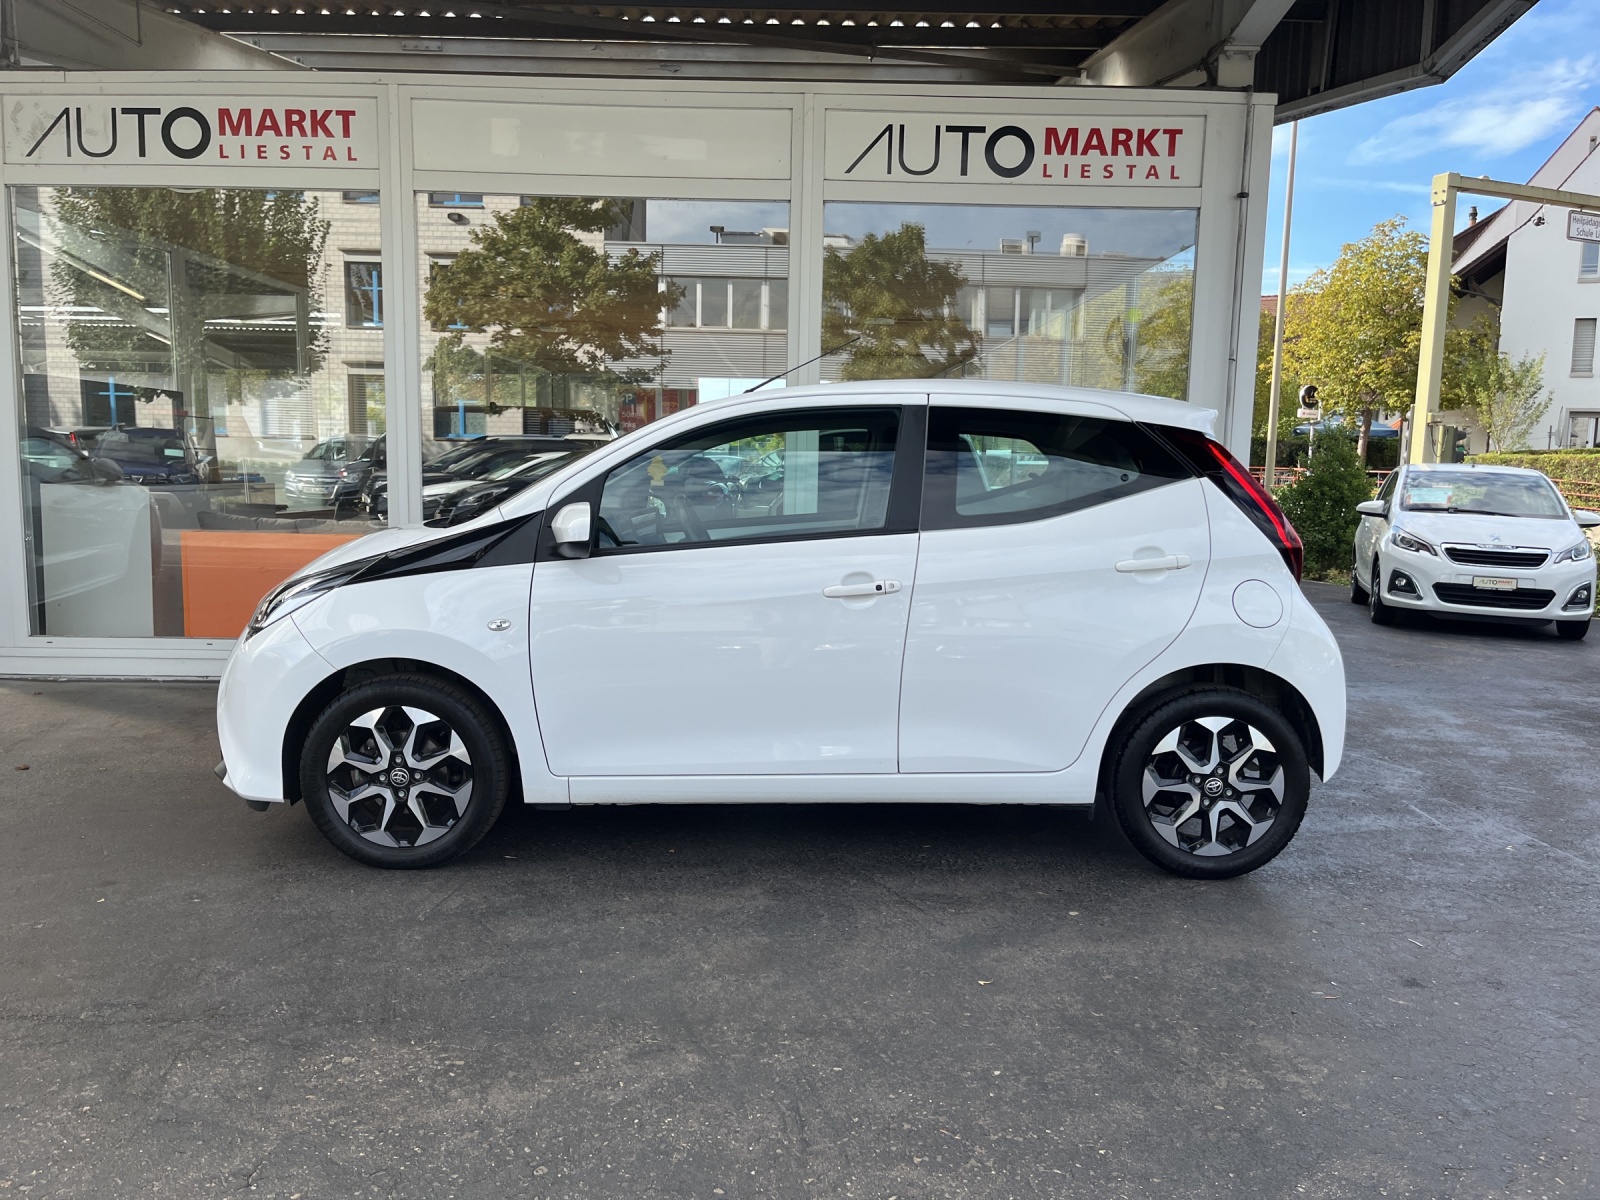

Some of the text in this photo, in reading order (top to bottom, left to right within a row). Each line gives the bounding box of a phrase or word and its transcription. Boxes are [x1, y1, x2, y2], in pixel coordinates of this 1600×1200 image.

[25, 106, 357, 159] AUTO MARKT
[218, 144, 358, 162] LIESTAL
[844, 123, 1184, 178] AUTO MARKT
[1042, 163, 1180, 180] LIESTAL
[1576, 228, 1593, 237] Schule
